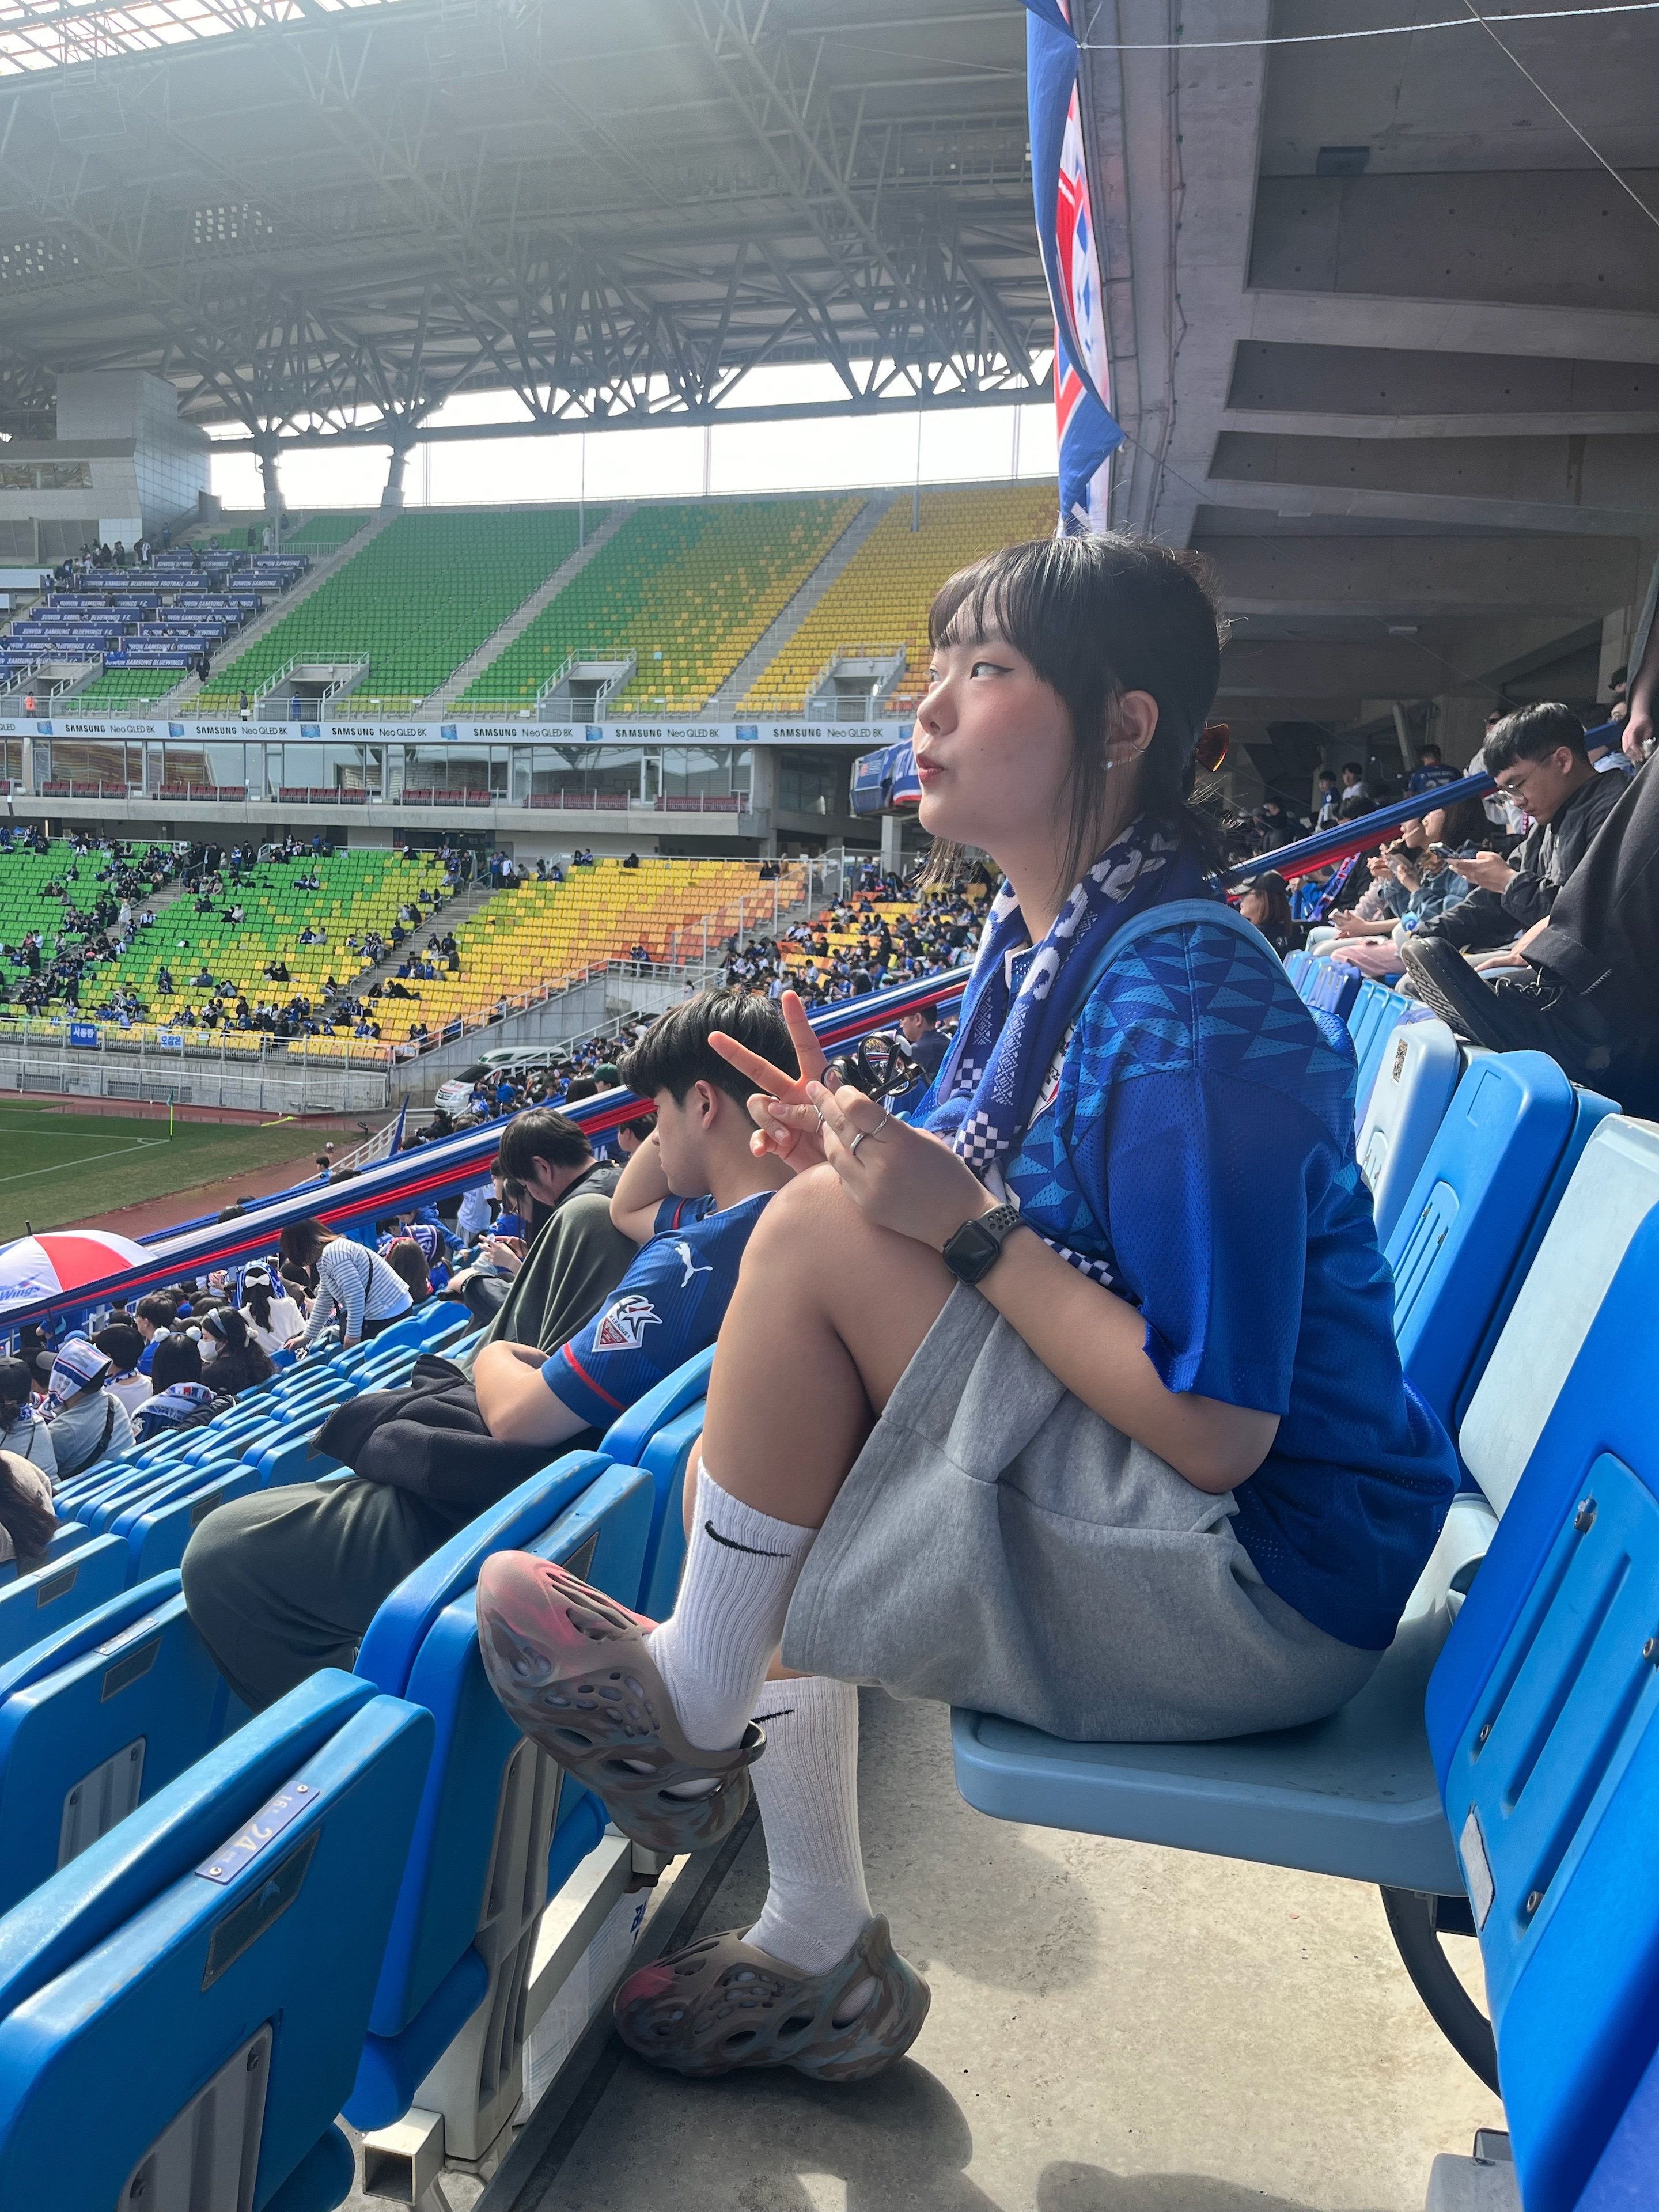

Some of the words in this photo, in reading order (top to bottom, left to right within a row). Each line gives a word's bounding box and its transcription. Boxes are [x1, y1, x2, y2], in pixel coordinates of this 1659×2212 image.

[127, 725, 145, 733] QLED
[196, 726, 236, 734] SAMSUNG
[259, 727, 278, 735] QLED
[279, 727, 288, 735] 8K
[332, 728, 374, 736] SAMSUNG
[380, 728, 396, 736] Neo
[396, 728, 416, 736] QLED
[418, 728, 427, 736] 8K
[522, 729, 540, 737] Neo
[541, 729, 562, 737] QLED
[563, 729, 573, 737] 8K
[616, 729, 661, 737] SAMSUNG
[668, 729, 685, 737] Neo
[687, 729, 709, 737] QLED
[710, 729, 719, 737] 8K
[774, 729, 821, 737] SAMSUNG
[828, 729, 847, 737] Neo
[849, 729, 872, 737] QLED
[873, 729, 883, 737] 8K
[612, 1318, 629, 1336] LEAGUE
